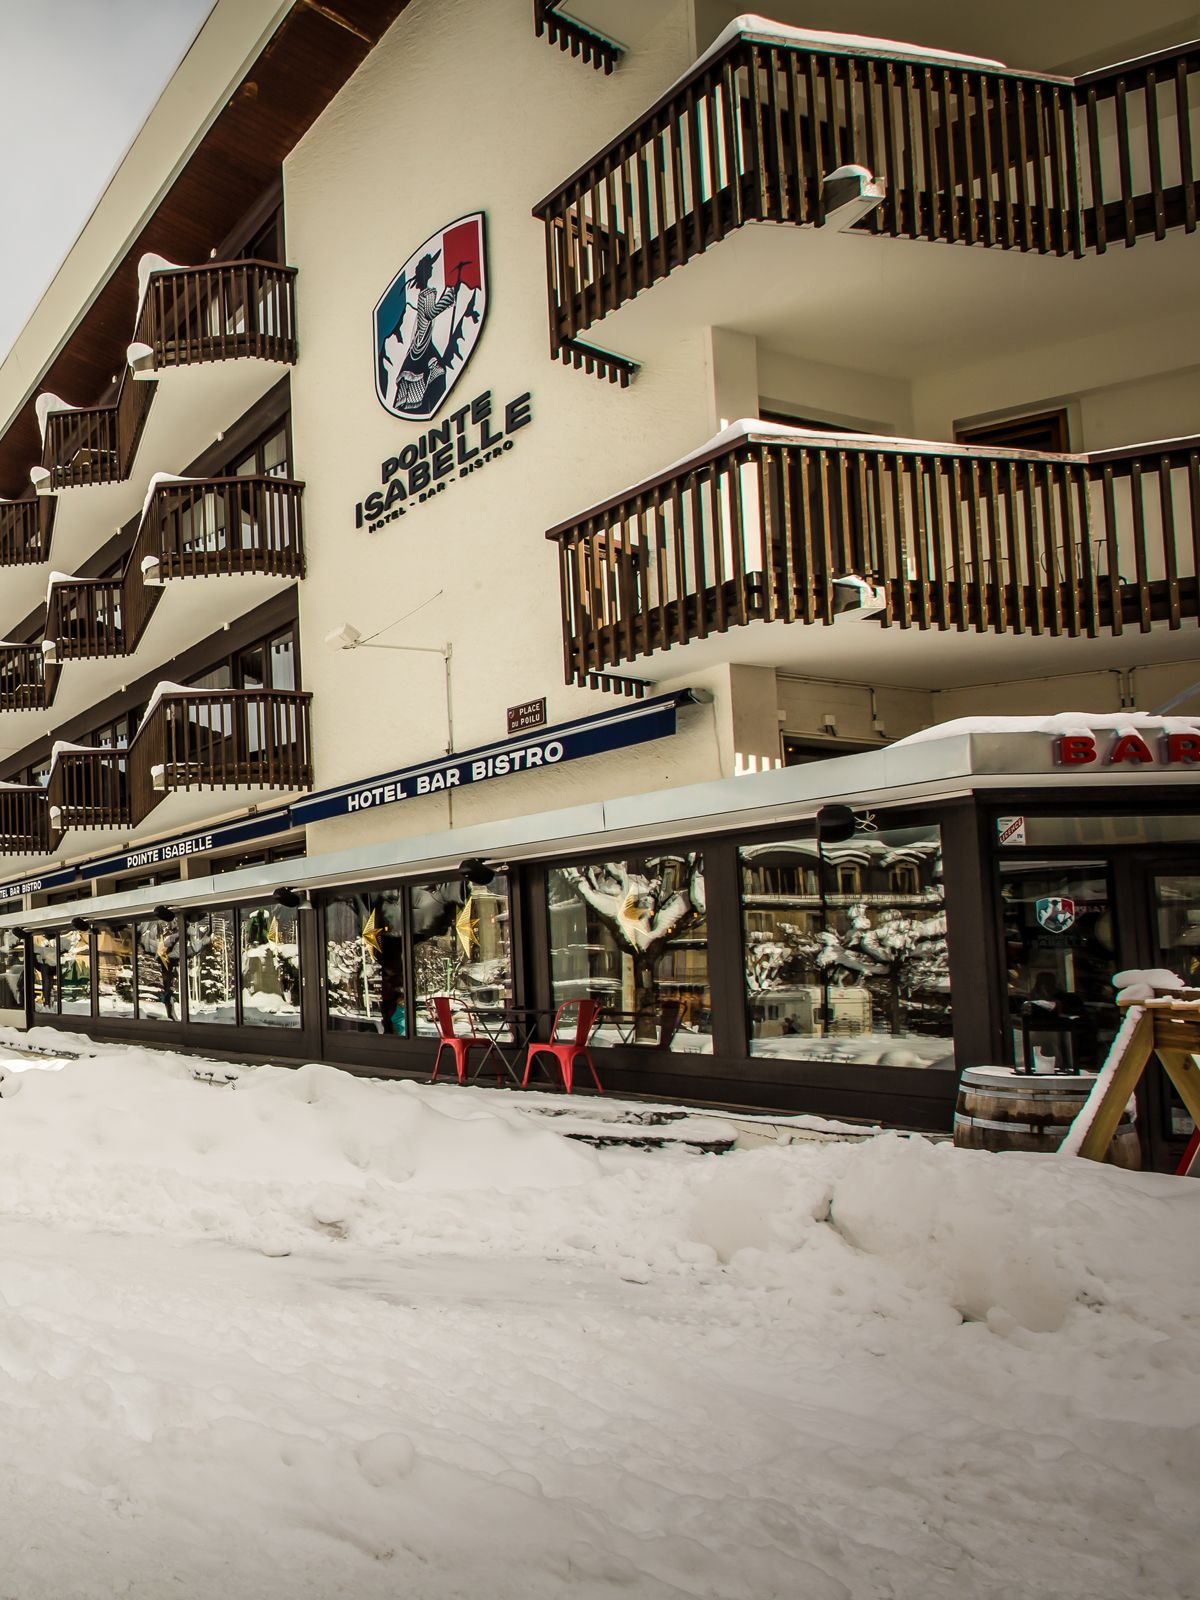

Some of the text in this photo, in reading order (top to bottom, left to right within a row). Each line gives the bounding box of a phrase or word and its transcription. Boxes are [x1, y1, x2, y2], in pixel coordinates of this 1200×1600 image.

[381, 390, 492, 485] POINTE
[355, 391, 532, 529] ISABELLE
[368, 506, 407, 534] HOTEL
[419, 482, 446, 504] BAR
[459, 439, 514, 479] BISTRO
[519, 703, 541, 716] PLACE
[520, 714, 540, 726] POILU
[1055, 733, 1200, 765] BAR
[347, 741, 565, 813] HOTEL BAR BISTRO
[999, 818, 1022, 843] LICENCE
[126, 835, 213, 869] POINTE ISABELLE
[9, 886, 21, 896] BAR
[21, 880, 42, 894] BISTRO
